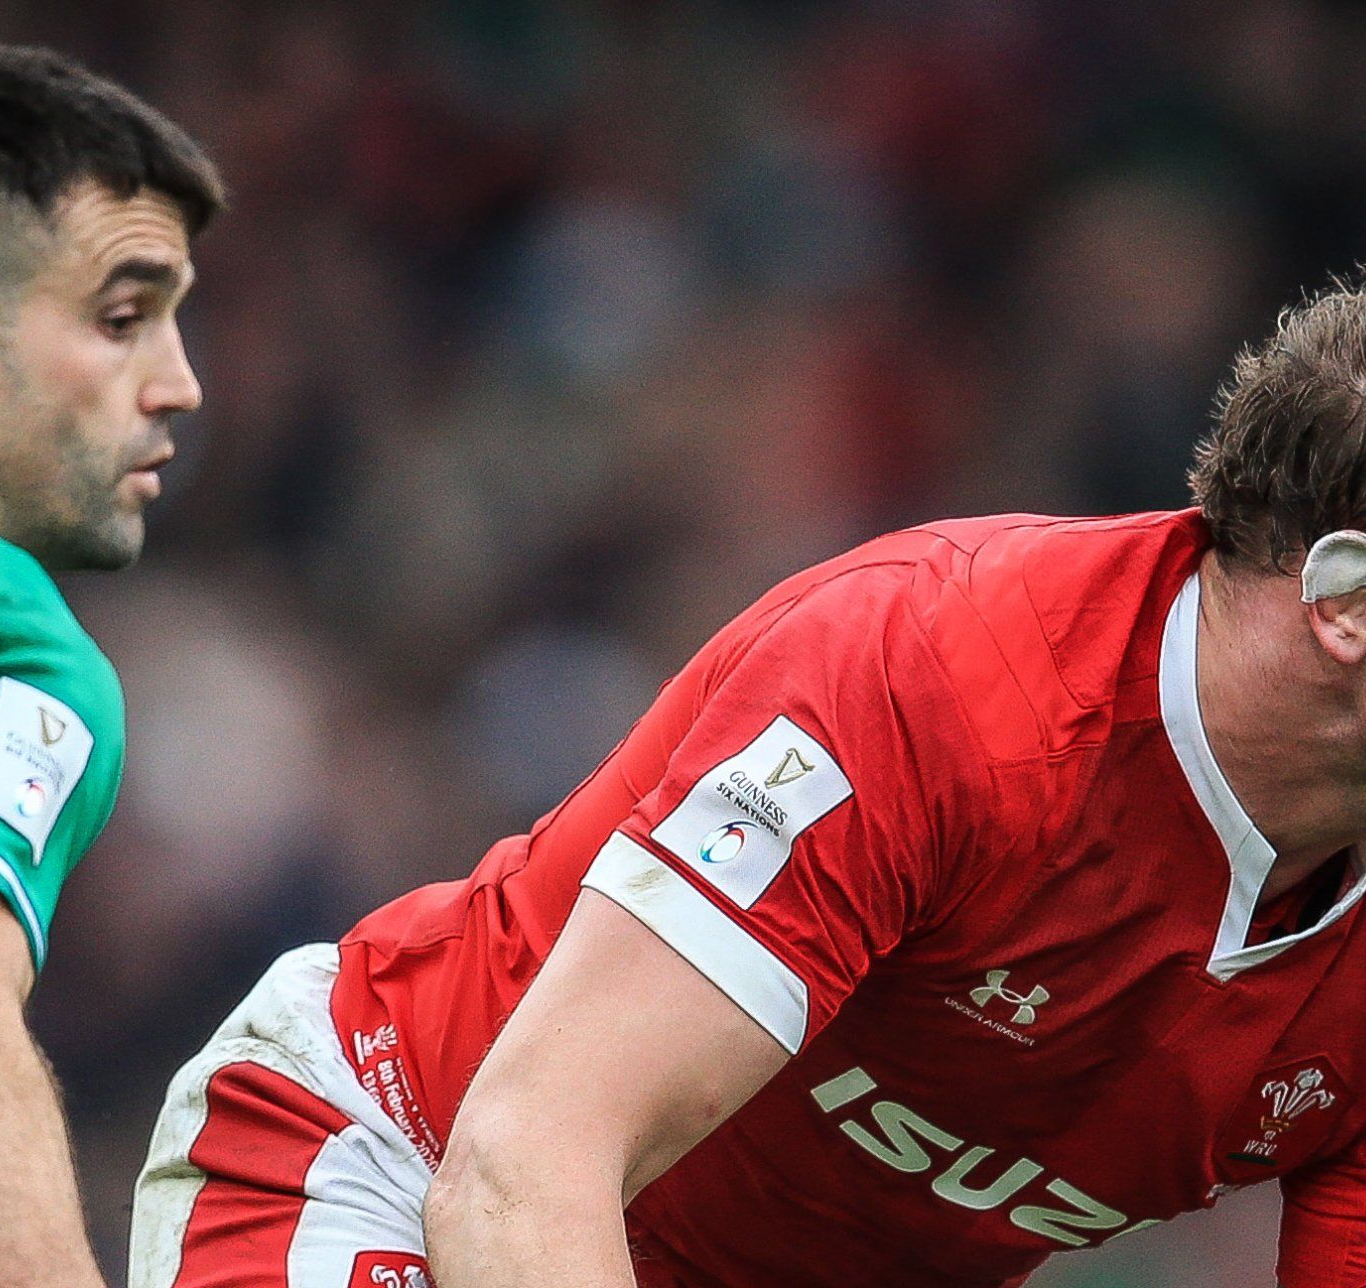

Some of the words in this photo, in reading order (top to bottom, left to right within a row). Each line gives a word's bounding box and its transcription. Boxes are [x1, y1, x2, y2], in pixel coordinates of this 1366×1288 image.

[716, 783, 733, 801] SIX
[734, 797, 780, 837] NATIONS
[729, 771, 787, 826] GUINNESS
[811, 1066, 1163, 1246] ISUZ
